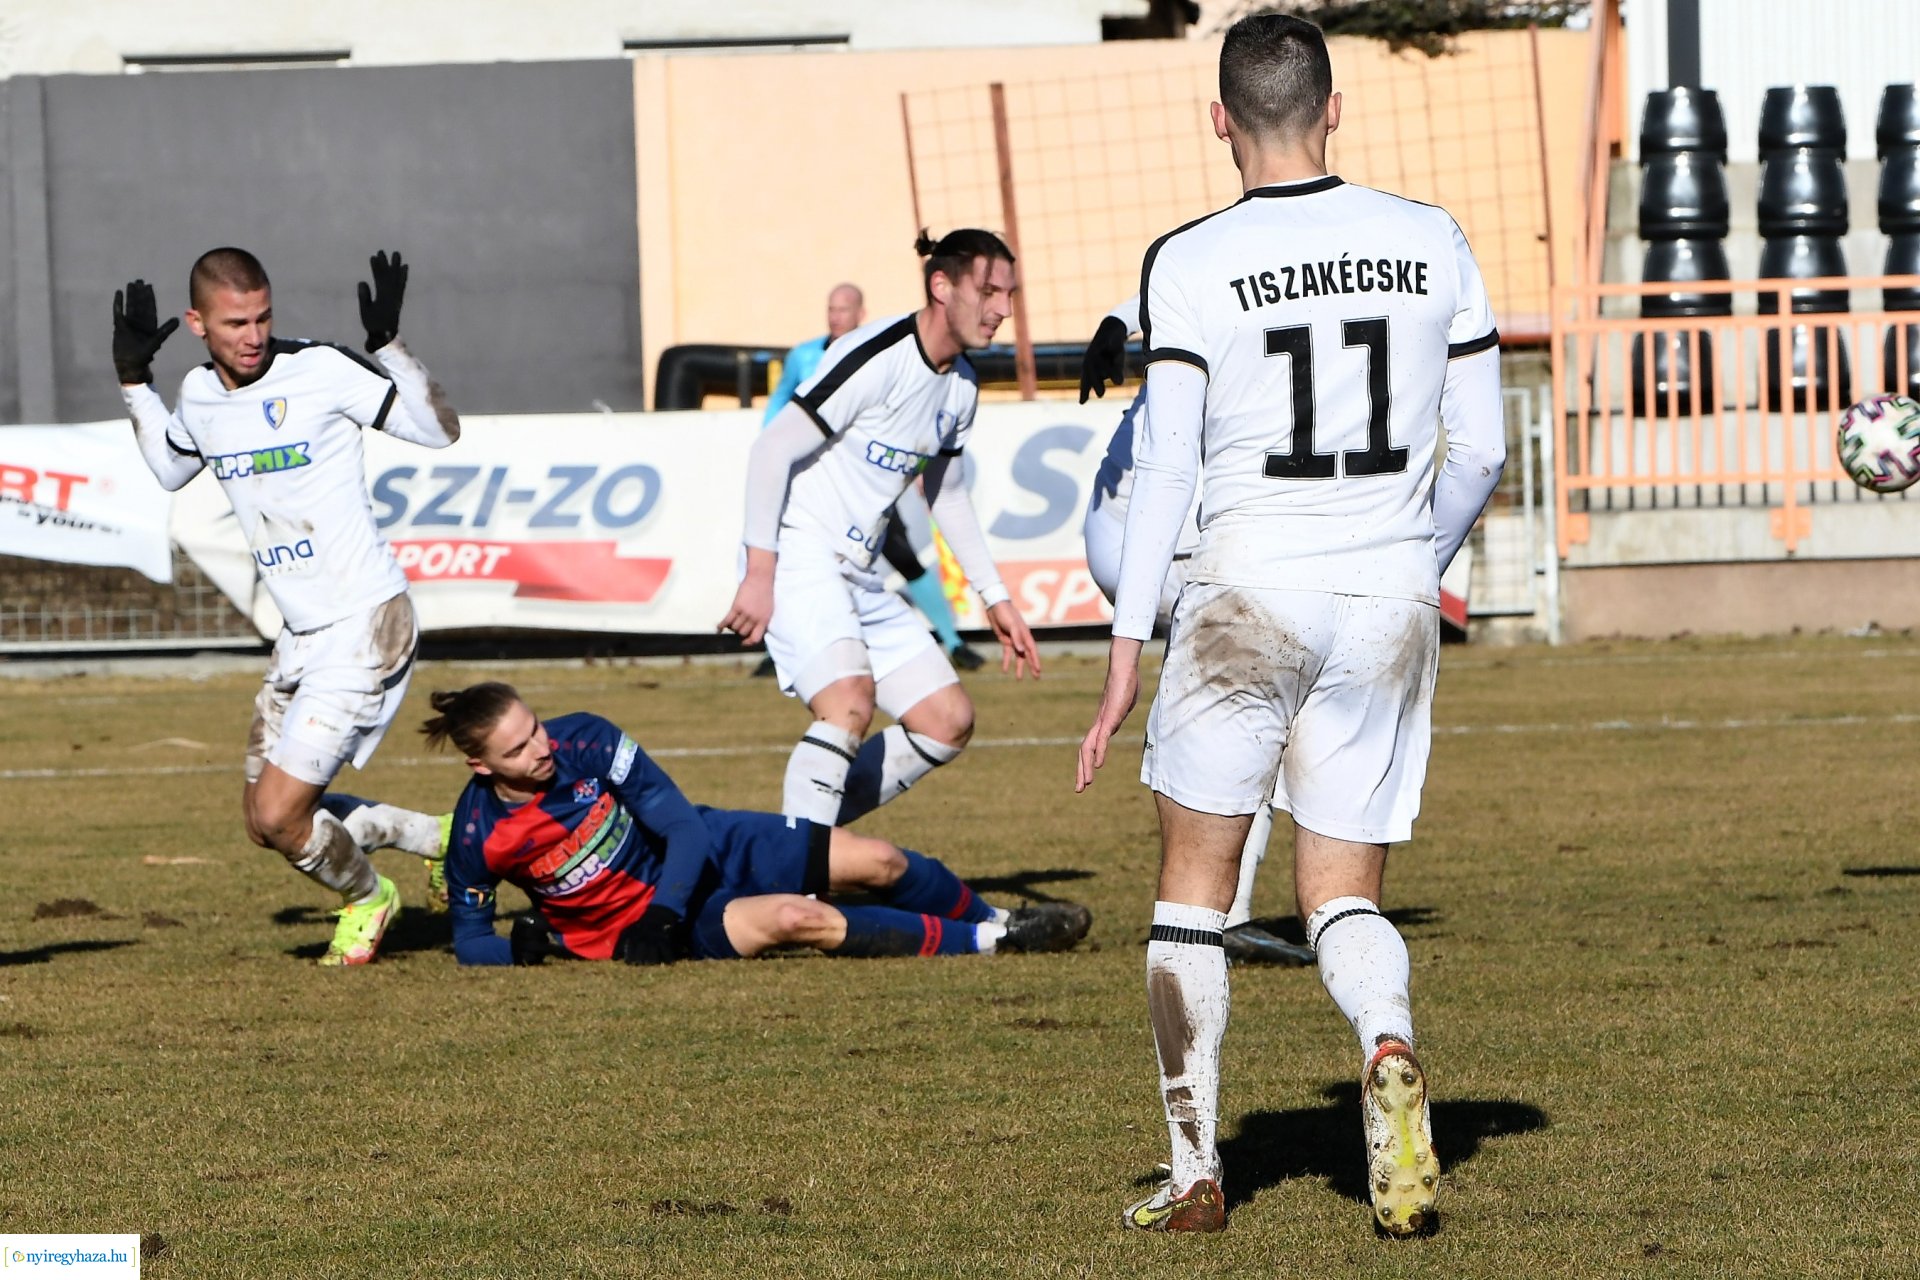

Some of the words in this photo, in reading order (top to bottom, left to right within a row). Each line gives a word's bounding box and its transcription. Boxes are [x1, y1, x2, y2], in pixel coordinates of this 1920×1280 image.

[1229, 252, 1428, 312] TISZAKÉCSKE
[1262, 315, 1411, 481] 11
[371, 463, 663, 530] SZI-ZO
[390, 542, 511, 576] PORT
